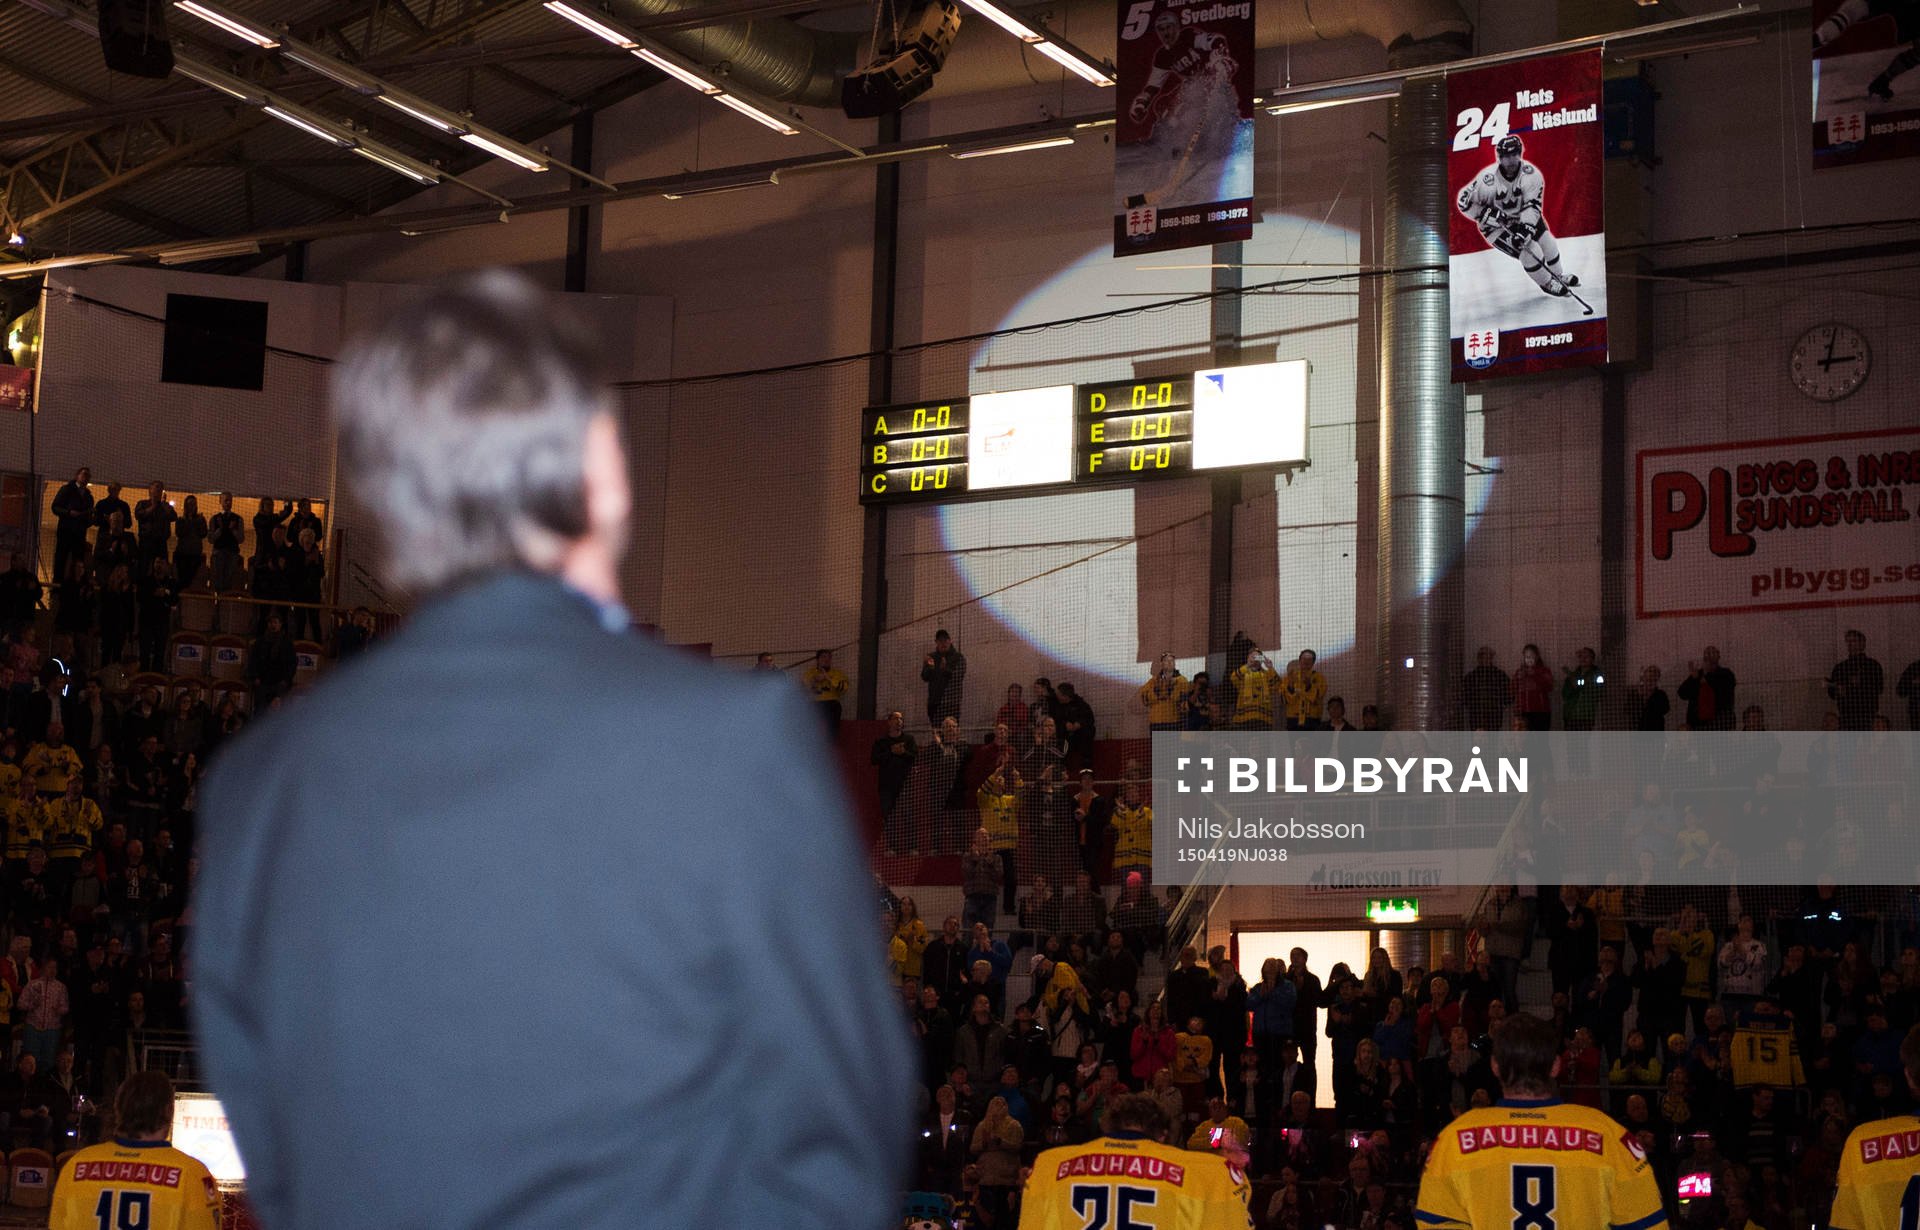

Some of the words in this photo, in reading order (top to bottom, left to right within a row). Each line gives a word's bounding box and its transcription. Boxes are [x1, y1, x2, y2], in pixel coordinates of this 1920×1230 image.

[1121, 0, 1156, 40] 5
[1181, 2, 1251, 25] Svedberg
[1516, 88, 1554, 110] Mats
[1452, 103, 1511, 152] 24
[1532, 104, 1597, 131] Näslund
[1207, 207, 1248, 222] 1969-1972
[1090, 393, 1107, 413] D
[1132, 383, 1172, 411] 0-0
[873, 416, 889, 435] A
[912, 406, 950, 432] 0-0
[1090, 424, 1105, 443] E
[1131, 413, 1171, 441] 0-0
[873, 445, 887, 464] B
[912, 437, 949, 461] 0-0
[1090, 453, 1103, 473] F
[1130, 443, 1170, 472] 0-0
[871, 474, 887, 493] C
[911, 467, 948, 491] 0-0
[1736, 459, 1819, 497] BYGG
[1825, 456, 1851, 490] &
[1651, 467, 1756, 560] PL
[1736, 488, 1911, 532] SUNDSVALL
[1751, 564, 1920, 597] plbygg.se
[1329, 867, 1402, 890] Claesson
[1748, 1038, 1777, 1063] 15
[1460, 1126, 1601, 1151] BAUHAUS
[75, 1162, 180, 1186] BAUHAUS
[1058, 1156, 1182, 1181] BAUHAUS
[1511, 1163, 1556, 1230] 8
